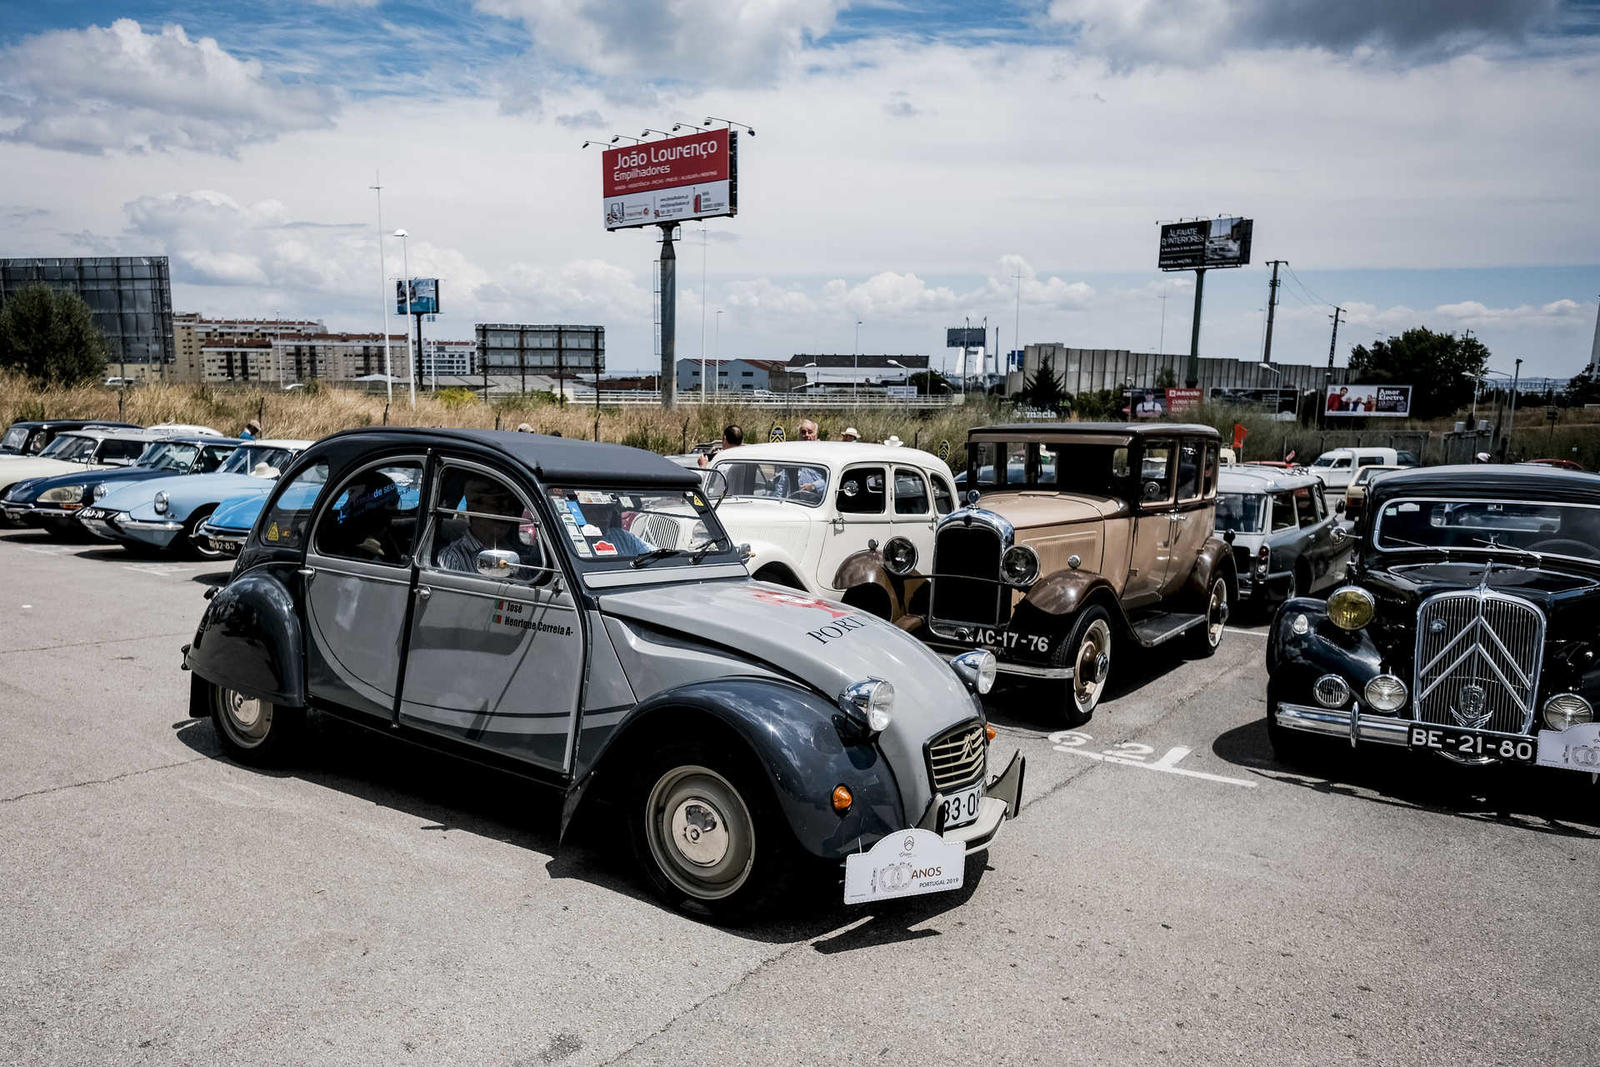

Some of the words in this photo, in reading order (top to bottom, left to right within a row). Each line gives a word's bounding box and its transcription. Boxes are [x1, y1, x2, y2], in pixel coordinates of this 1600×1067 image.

[613, 151, 648, 170] João
[650, 140, 718, 163] Lourenço
[613, 164, 671, 182] Empilhadores
[1378, 388, 1401, 396] Amor
[504, 615, 536, 631] Henrique
[536, 621, 565, 635] Correia
[975, 627, 1050, 653] AC-17-76
[1411, 729, 1533, 761] BE-21-80
[911, 866, 942, 880] ANOS
[919, 879, 946, 889] PORTUGAL
[946, 877, 960, 886] 2019
